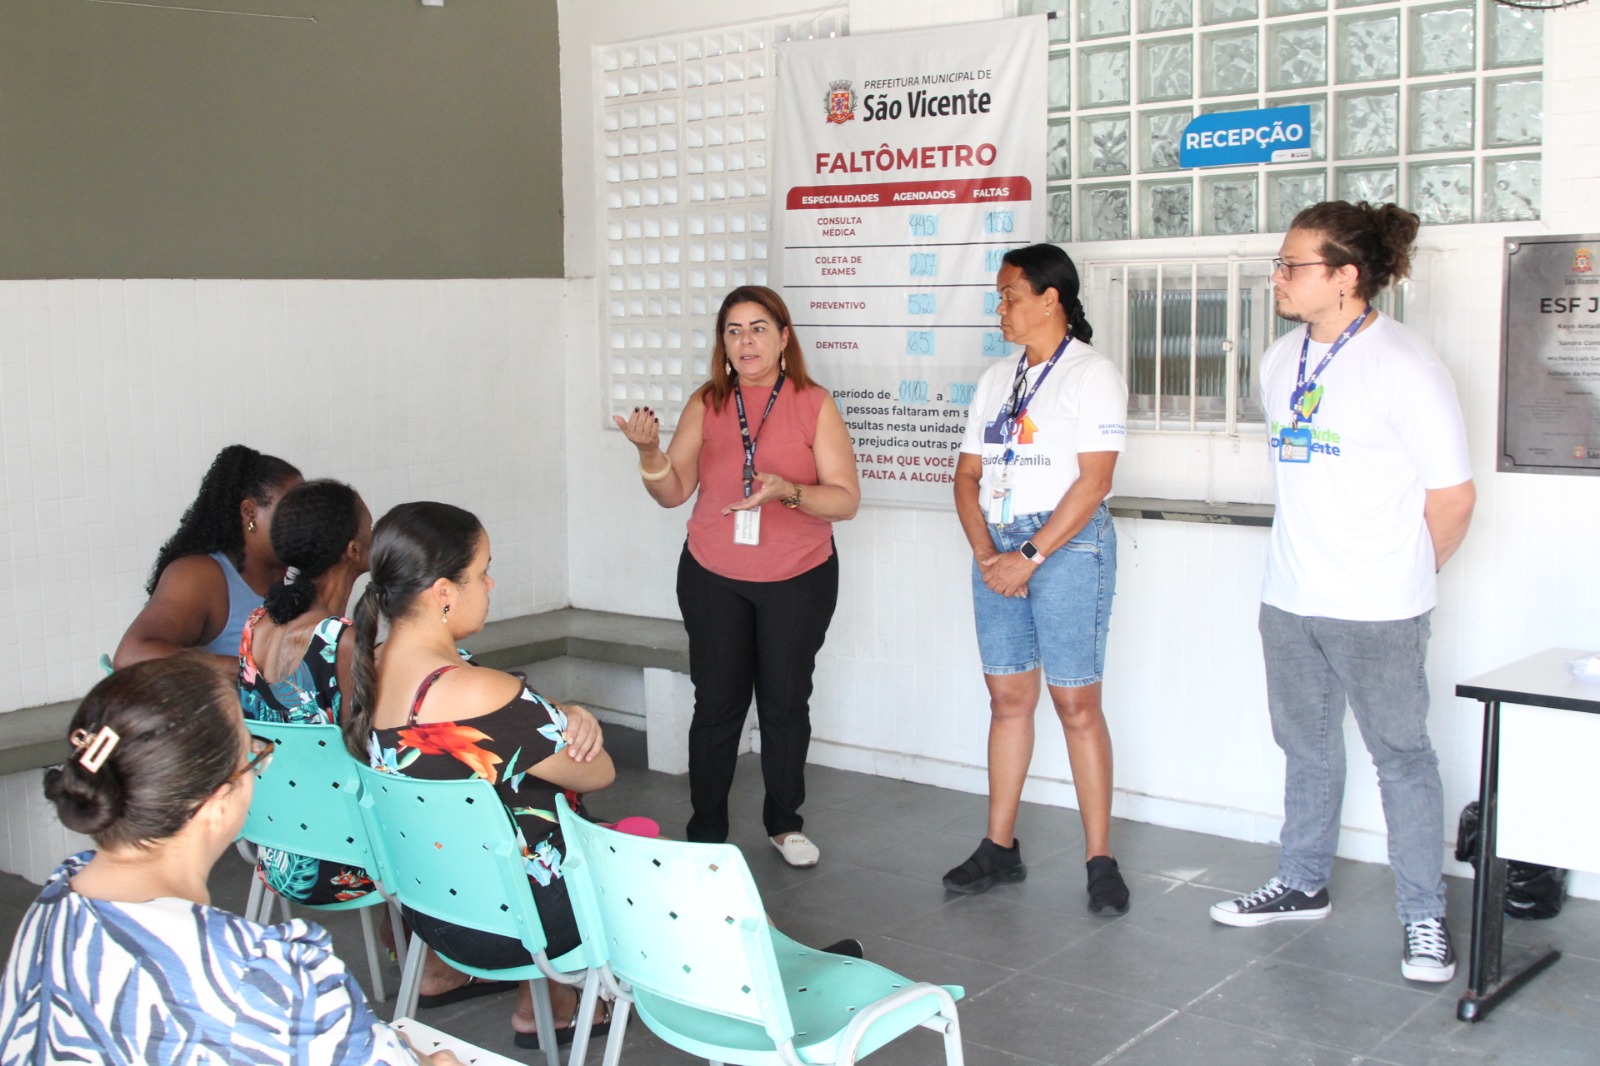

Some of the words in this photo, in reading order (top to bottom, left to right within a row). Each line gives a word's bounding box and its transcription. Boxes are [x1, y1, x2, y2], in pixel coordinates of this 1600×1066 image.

[864, 76, 920, 90] PREFEITURA
[921, 71, 975, 86] MUNICIPAL
[977, 69, 992, 81] DE
[863, 93, 902, 122] São
[908, 88, 991, 119] Vicente
[1186, 121, 1303, 149] RECEPÇÃO
[816, 143, 997, 175] FALTÔMETRO
[801, 193, 879, 205] ESPECIALIDADES
[893, 189, 956, 202] AGENDADOS
[973, 186, 1010, 198] FALTAS
[817, 216, 862, 226] CONSULTA
[822, 225, 856, 237] MÉDICA
[815, 255, 849, 265] COLETA
[850, 256, 862, 265] DE
[821, 267, 856, 276] EXAMES
[810, 301, 866, 310] PREVENTIVO
[908, 293, 933, 315] 52
[1540, 298, 1581, 314] ESF
[1588, 298, 1599, 314] J
[816, 341, 859, 350] DENTISTA
[908, 331, 931, 354] 65
[833, 388, 874, 399] período
[877, 389, 891, 400] de
[936, 393, 943, 401] a
[846, 405, 890, 416] pessoas
[892, 405, 940, 417] faltaram
[942, 409, 960, 418] em
[845, 420, 884, 431] nsultas
[887, 422, 916, 432] nesta
[919, 422, 966, 434] unidade
[858, 435, 909, 449] prejudica
[911, 439, 947, 449] outras
[854, 453, 873, 464] LTA
[877, 454, 893, 465] EM
[896, 455, 920, 467] QUE
[924, 456, 954, 468] VOCÊ
[862, 469, 896, 481] FALTA
[899, 472, 908, 481] A
